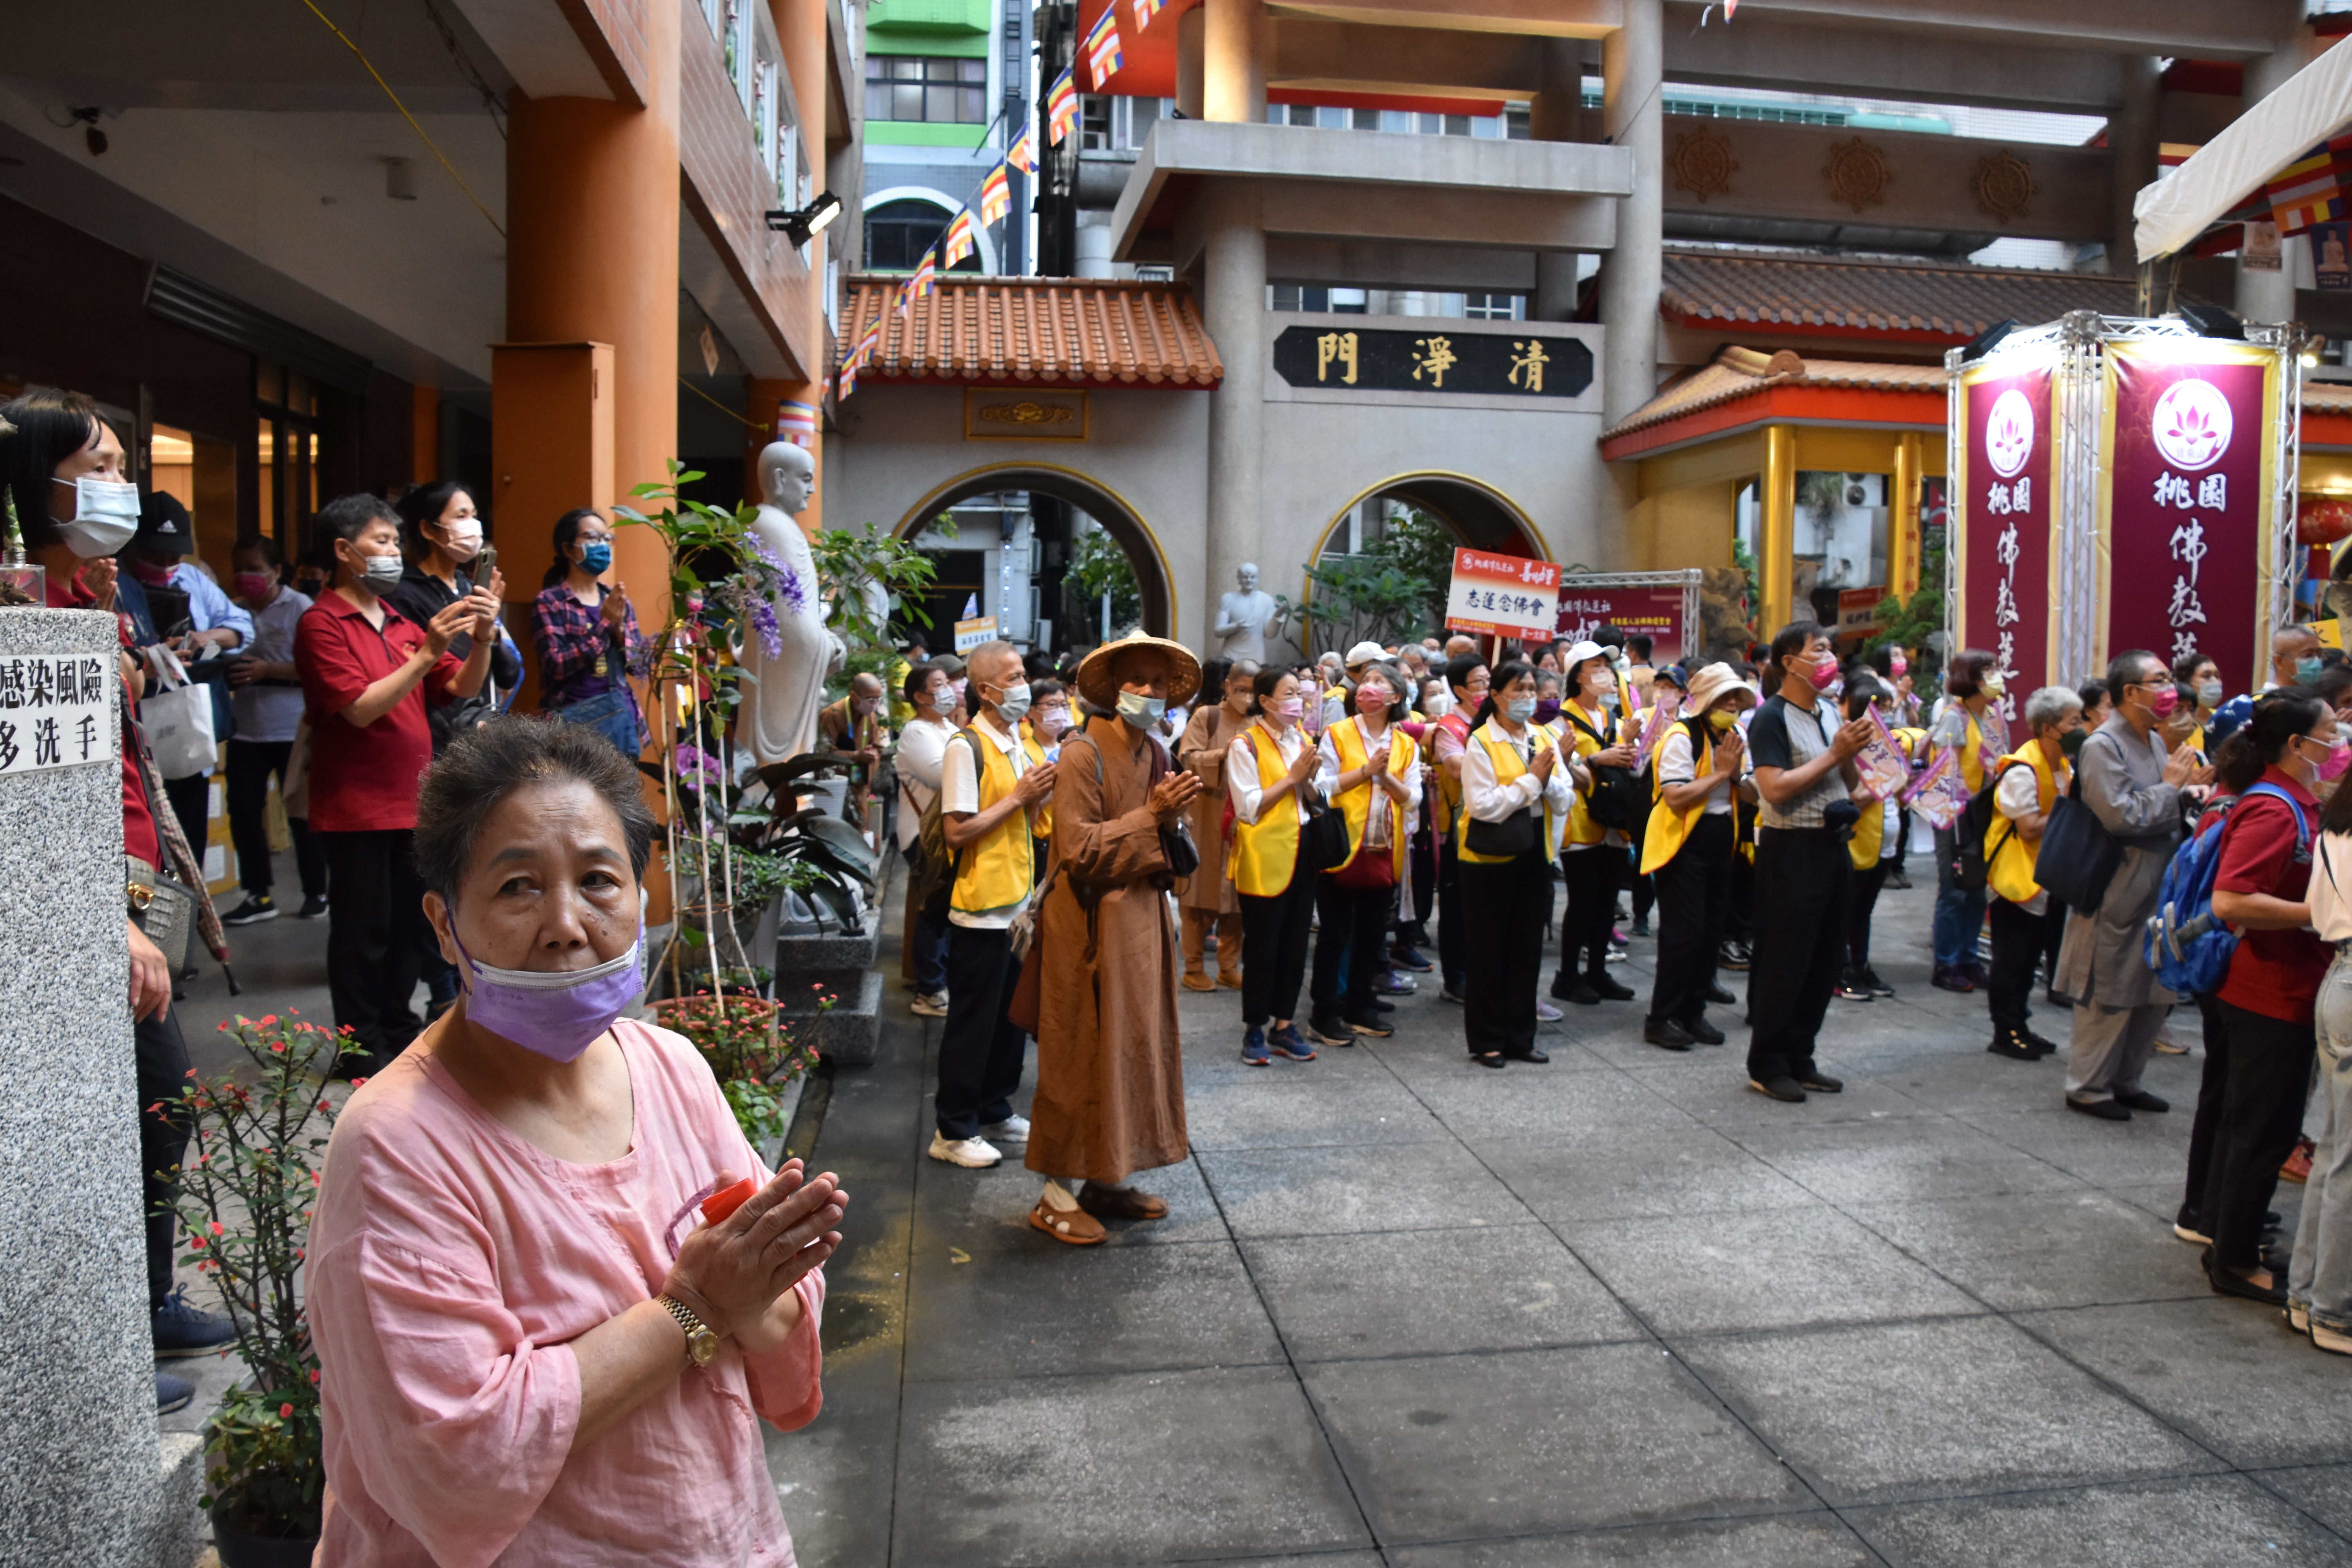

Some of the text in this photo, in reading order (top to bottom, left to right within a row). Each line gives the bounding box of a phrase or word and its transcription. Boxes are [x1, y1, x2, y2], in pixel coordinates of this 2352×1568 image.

[1987, 476, 2031, 515] 桃園
[2153, 470, 2227, 512] 桃園
[0, 658, 102, 709] 感染風險
